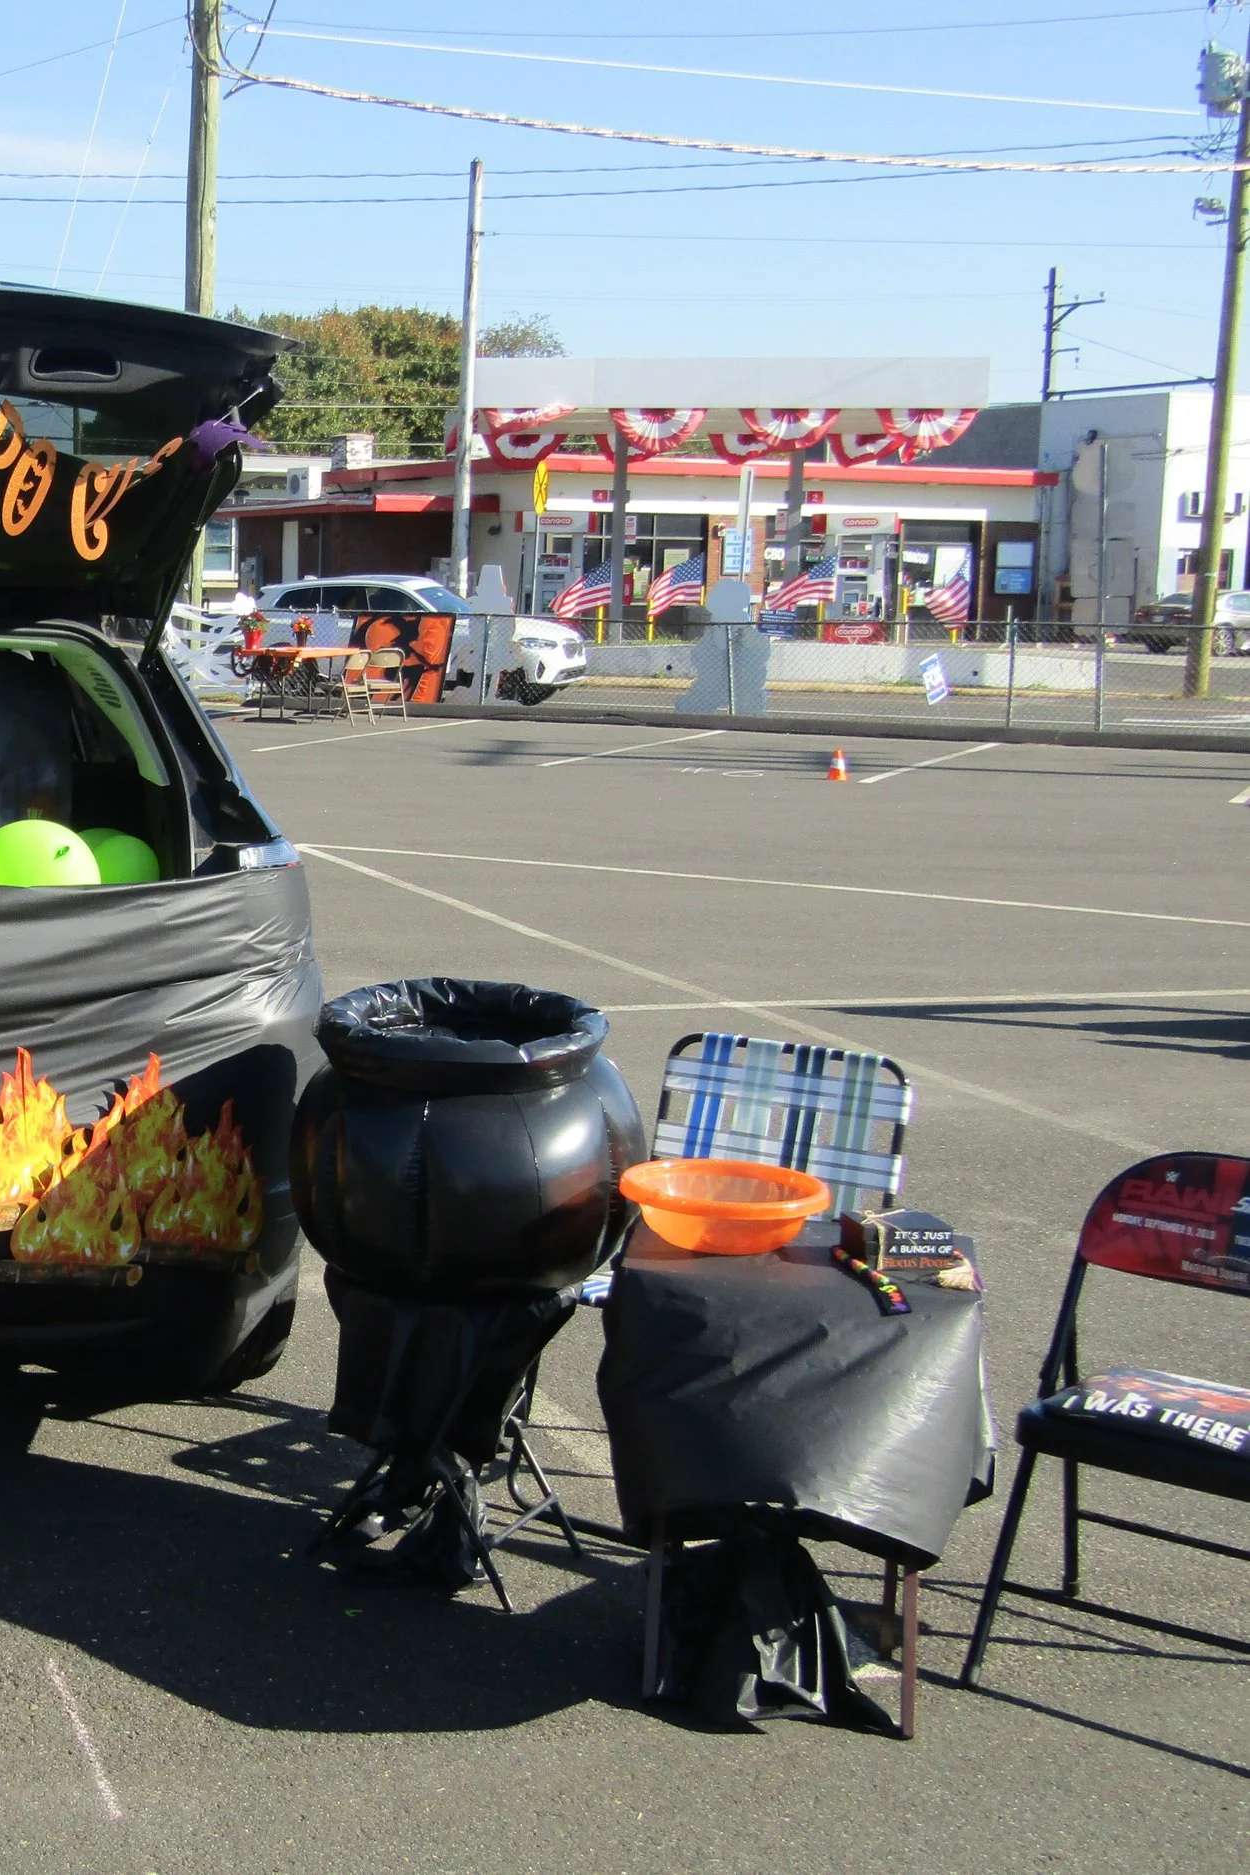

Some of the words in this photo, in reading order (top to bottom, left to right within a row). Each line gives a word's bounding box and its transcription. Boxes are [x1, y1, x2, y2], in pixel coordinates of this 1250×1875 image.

[812, 494, 818, 502] 2
[894, 1231, 919, 1240] IT'S
[922, 1231, 952, 1240] JUST
[889, 1245, 897, 1253] A
[900, 1244, 935, 1254] BUNCH
[937, 1245, 953, 1254] OF
[1062, 1395, 1078, 1409] I
[1083, 1394, 1153, 1418] WAS
